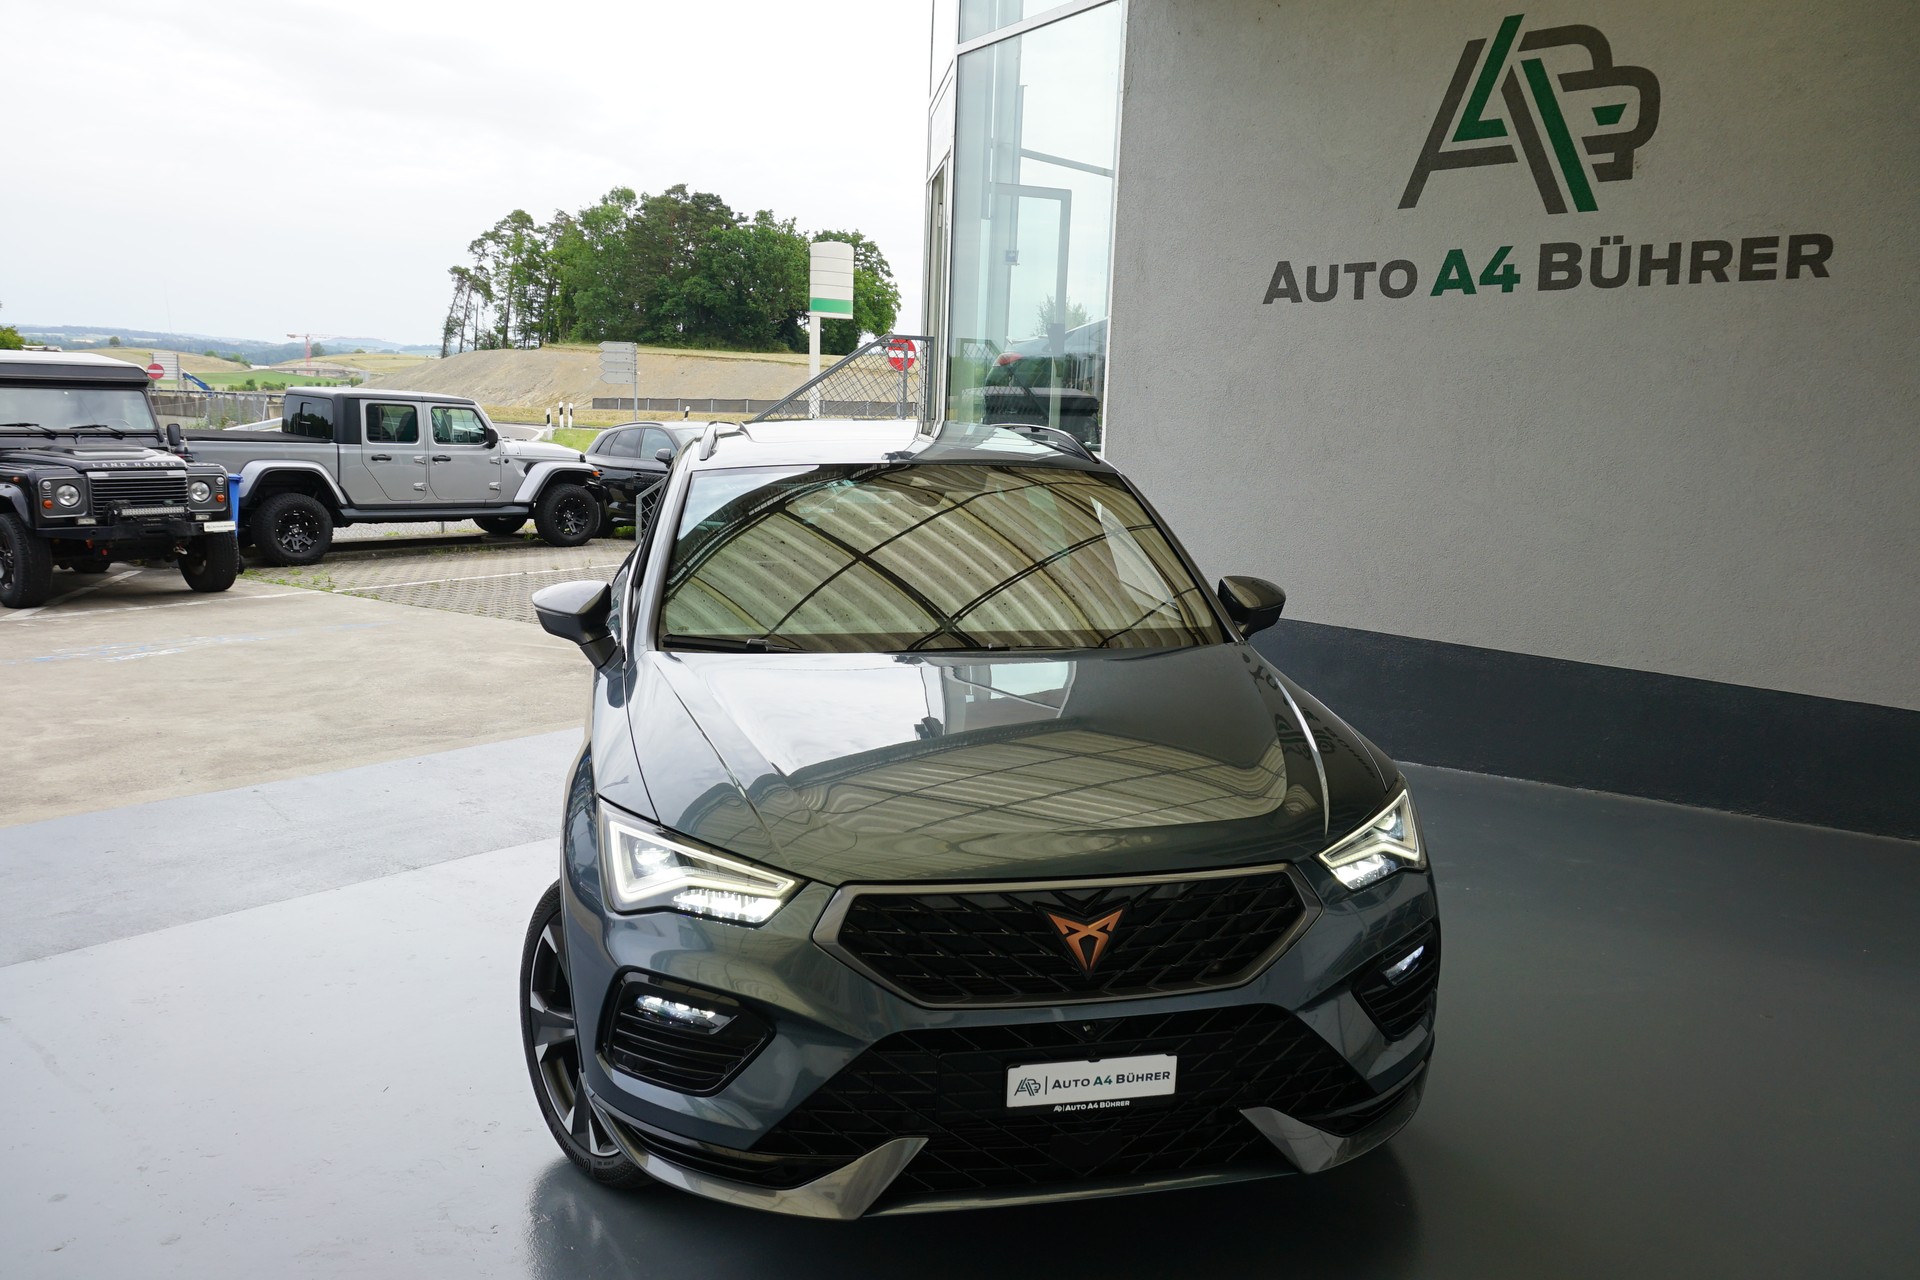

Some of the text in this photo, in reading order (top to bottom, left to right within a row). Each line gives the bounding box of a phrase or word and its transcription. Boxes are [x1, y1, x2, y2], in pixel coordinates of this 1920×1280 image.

[1263, 233, 1835, 305] AUTO A4 BÜHRER
[1051, 1078, 1091, 1090] AUTO
[1093, 1075, 1113, 1087] A4
[1116, 1071, 1171, 1084] BÜHRER
[1065, 1103, 1087, 1111] AUTO
[1099, 1100, 1131, 1109] BÜHRER
